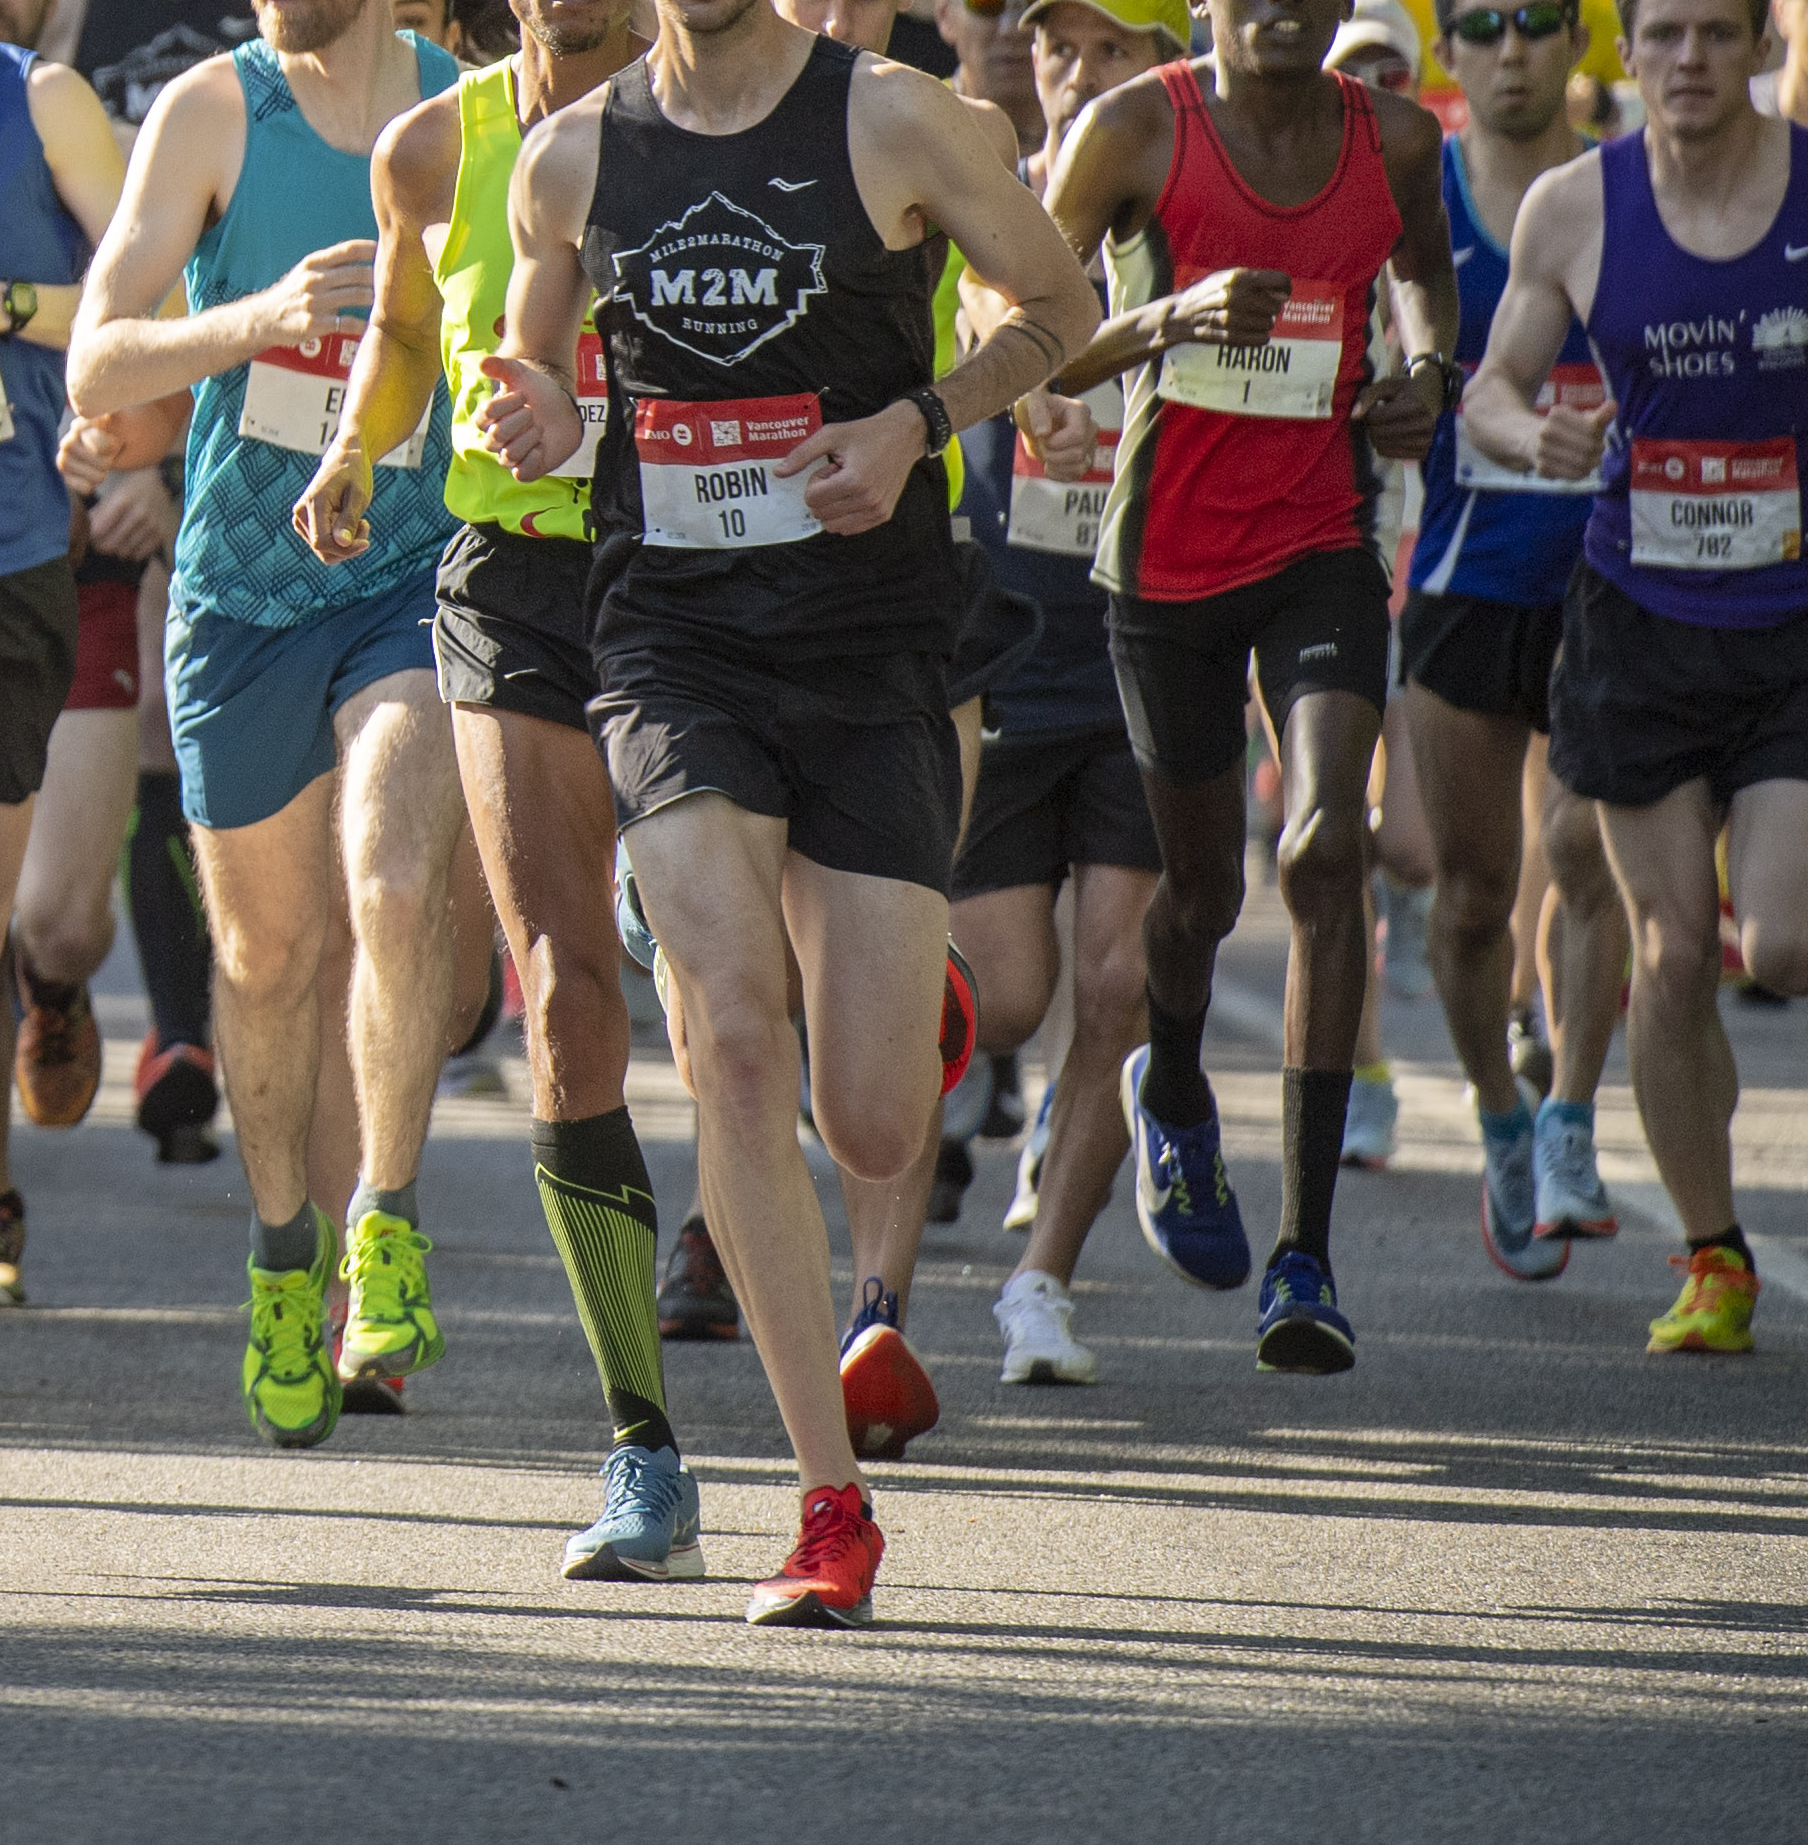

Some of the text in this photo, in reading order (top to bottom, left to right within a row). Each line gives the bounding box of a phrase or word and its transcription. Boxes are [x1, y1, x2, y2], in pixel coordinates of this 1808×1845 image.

[649, 233, 785, 263] MILE2MARATHON
[650, 268, 779, 306] M2M
[682, 317, 758, 335] RUNNING
[1217, 344, 1291, 374] HARON
[1649, 351, 1735, 379] SHOES
[1243, 379, 1251, 404] 1
[745, 416, 809, 431] Vancouver
[748, 428, 807, 442] Marathon
[694, 466, 768, 503] ROBIN
[718, 508, 746, 538] 10
[1671, 499, 1753, 527] CONNOR
